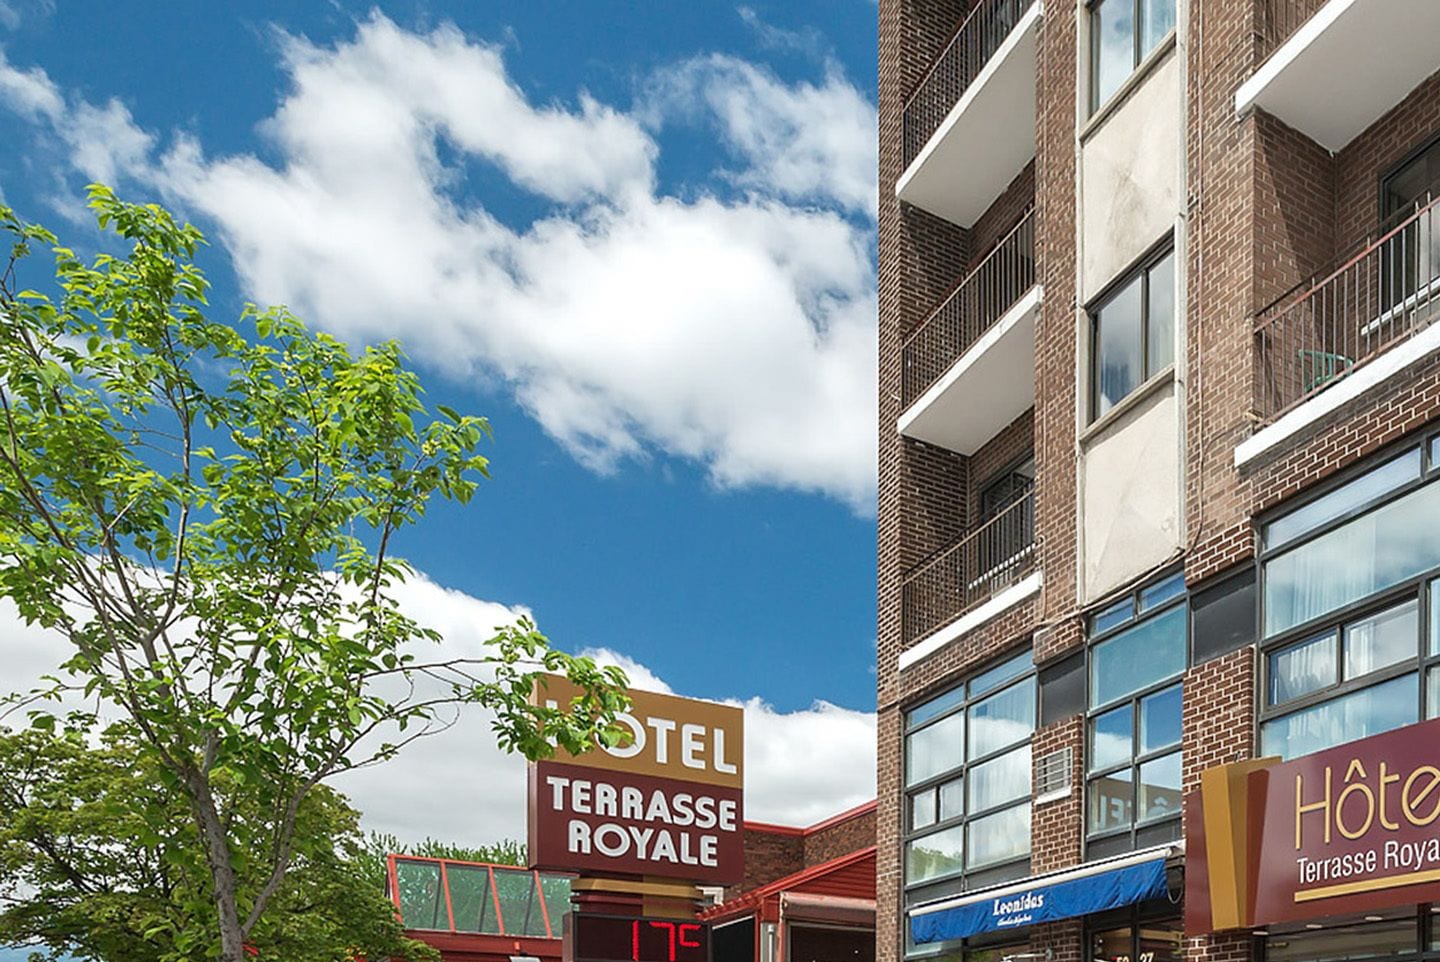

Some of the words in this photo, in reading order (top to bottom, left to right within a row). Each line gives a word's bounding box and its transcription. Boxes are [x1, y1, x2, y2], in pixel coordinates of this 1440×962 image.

[546, 776, 736, 831] TERRASSE
[568, 819, 718, 867] ROYALE
[1297, 848, 1376, 884] Terrasse
[993, 892, 1044, 916] Leonidas
